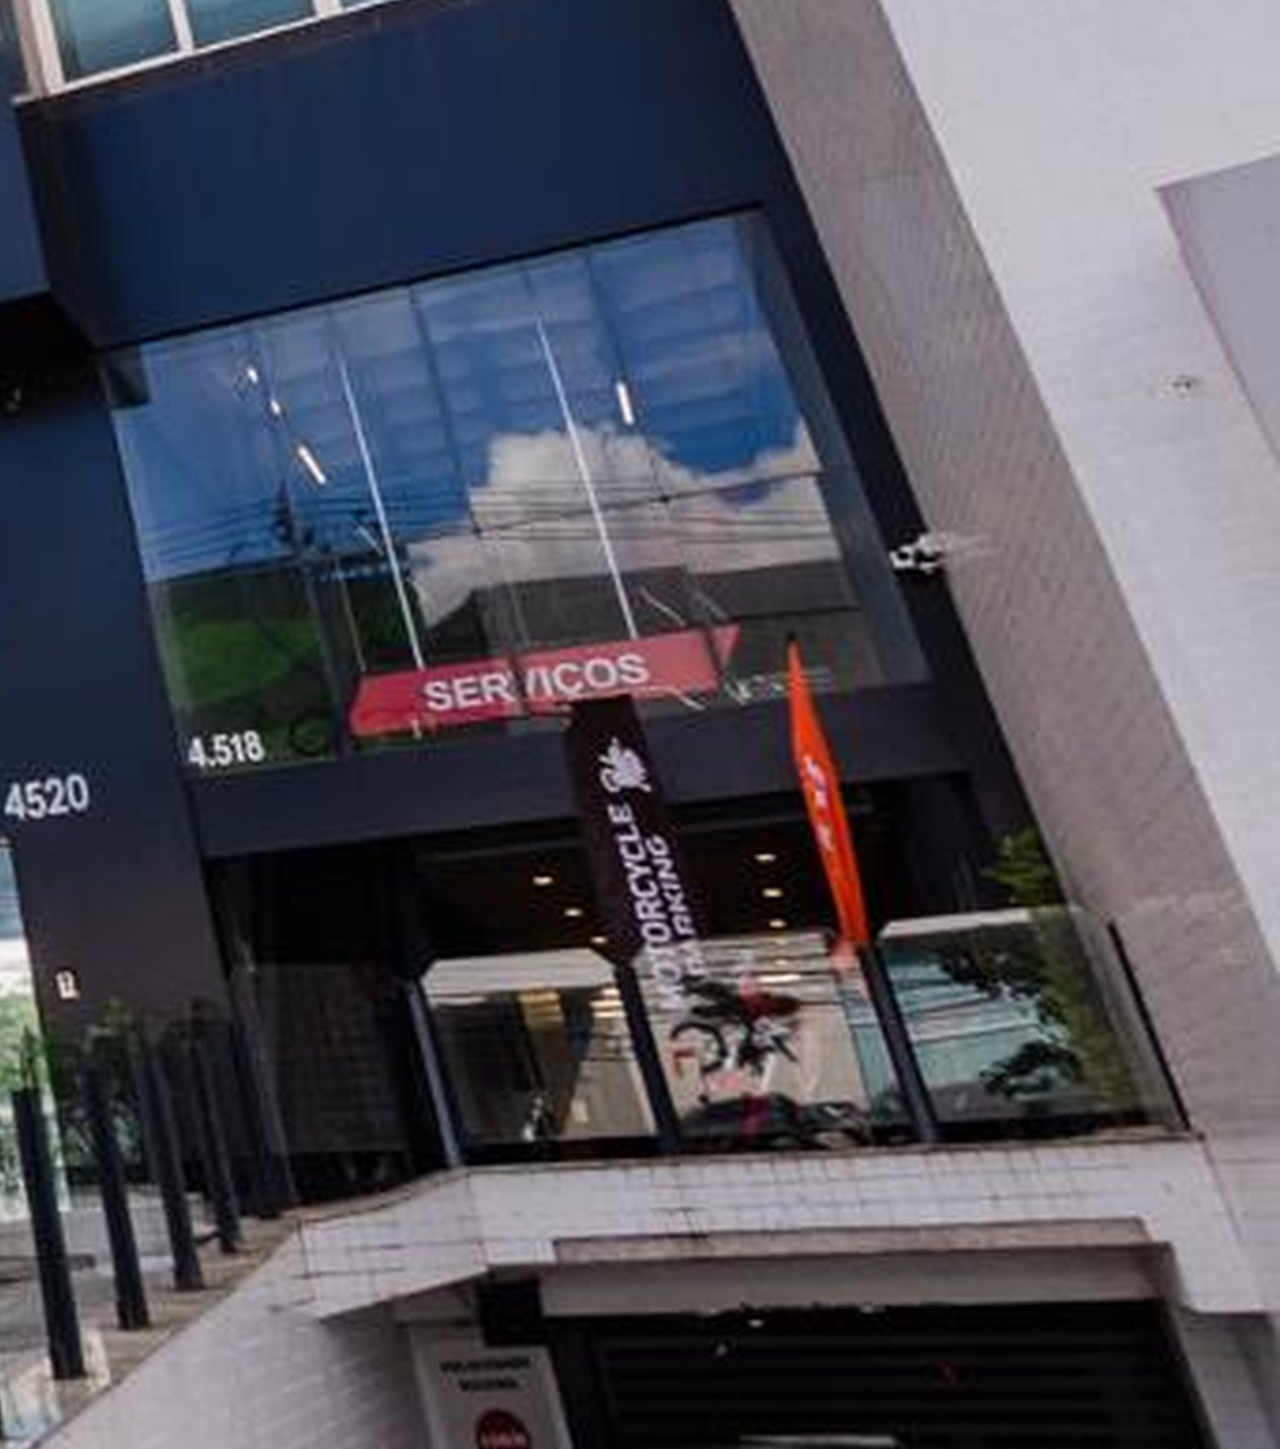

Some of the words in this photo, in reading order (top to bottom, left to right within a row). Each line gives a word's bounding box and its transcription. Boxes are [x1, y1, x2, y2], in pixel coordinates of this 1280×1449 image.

[188, 730, 265, 768] 4.518
[4, 773, 90, 820] 4520
[607, 802, 686, 1011] MOTORCYCLE
[645, 834, 707, 976] PARKING
